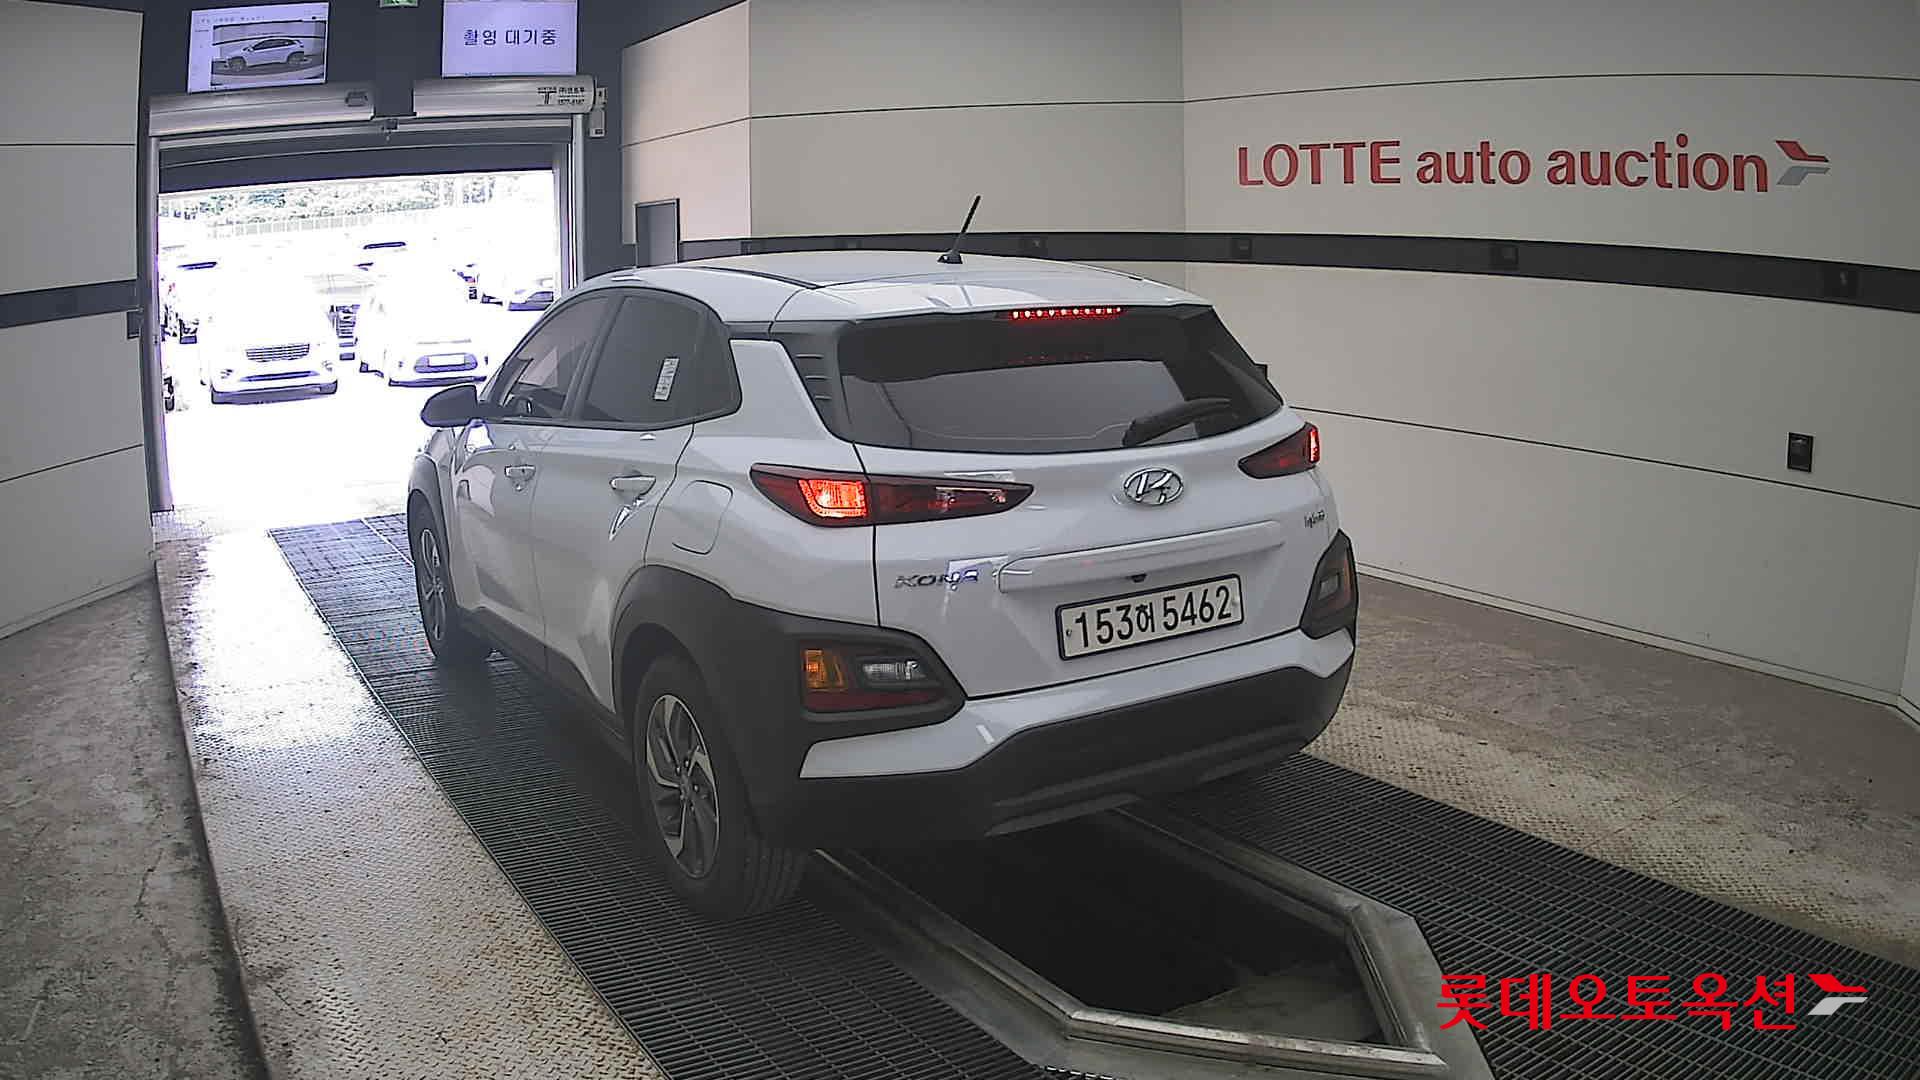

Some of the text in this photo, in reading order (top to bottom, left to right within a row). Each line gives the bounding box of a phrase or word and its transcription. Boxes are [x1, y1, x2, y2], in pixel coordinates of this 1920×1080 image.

[505, 28, 557, 46] 대기중
[1237, 133, 1769, 193] LOTTE auto auction
